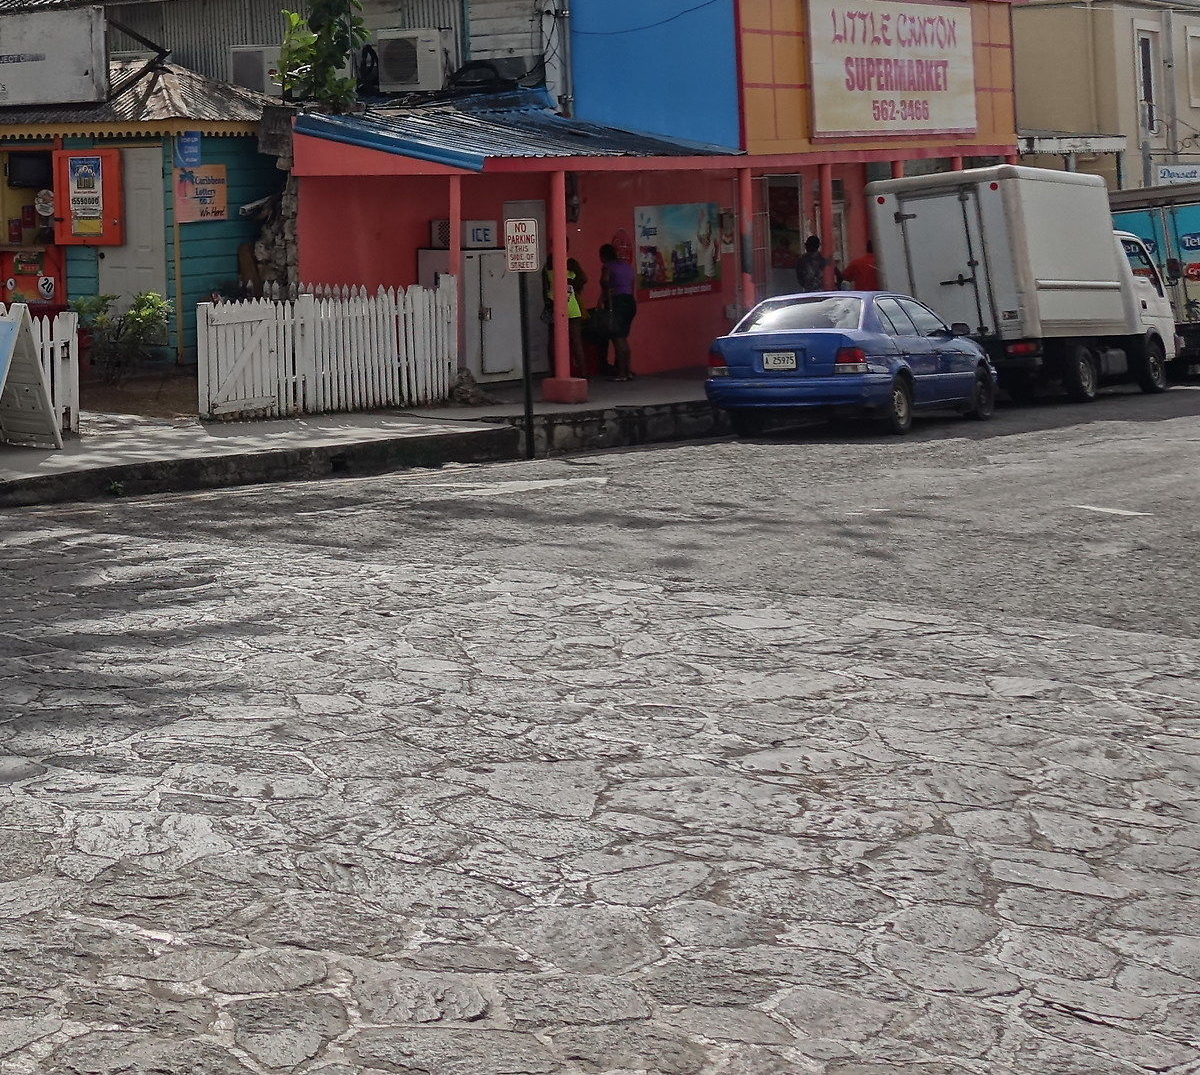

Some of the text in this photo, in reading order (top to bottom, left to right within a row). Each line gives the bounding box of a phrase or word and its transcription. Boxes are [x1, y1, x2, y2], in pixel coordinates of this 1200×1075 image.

[830, 8, 892, 47] LITTLE
[844, 56, 949, 92] SUPERMARKET
[872, 99, 930, 121] 562-3466
[195, 175, 226, 185] Caribbean
[195, 188, 216, 198] Lottery
[201, 207, 211, 217] Win
[514, 223, 527, 233] NO
[472, 228, 491, 242] ICE
[507, 234, 535, 244] PARKING
[510, 261, 534, 269] STREET
[41, 277, 54, 294] 20
[773, 356, 795, 365] 25975
